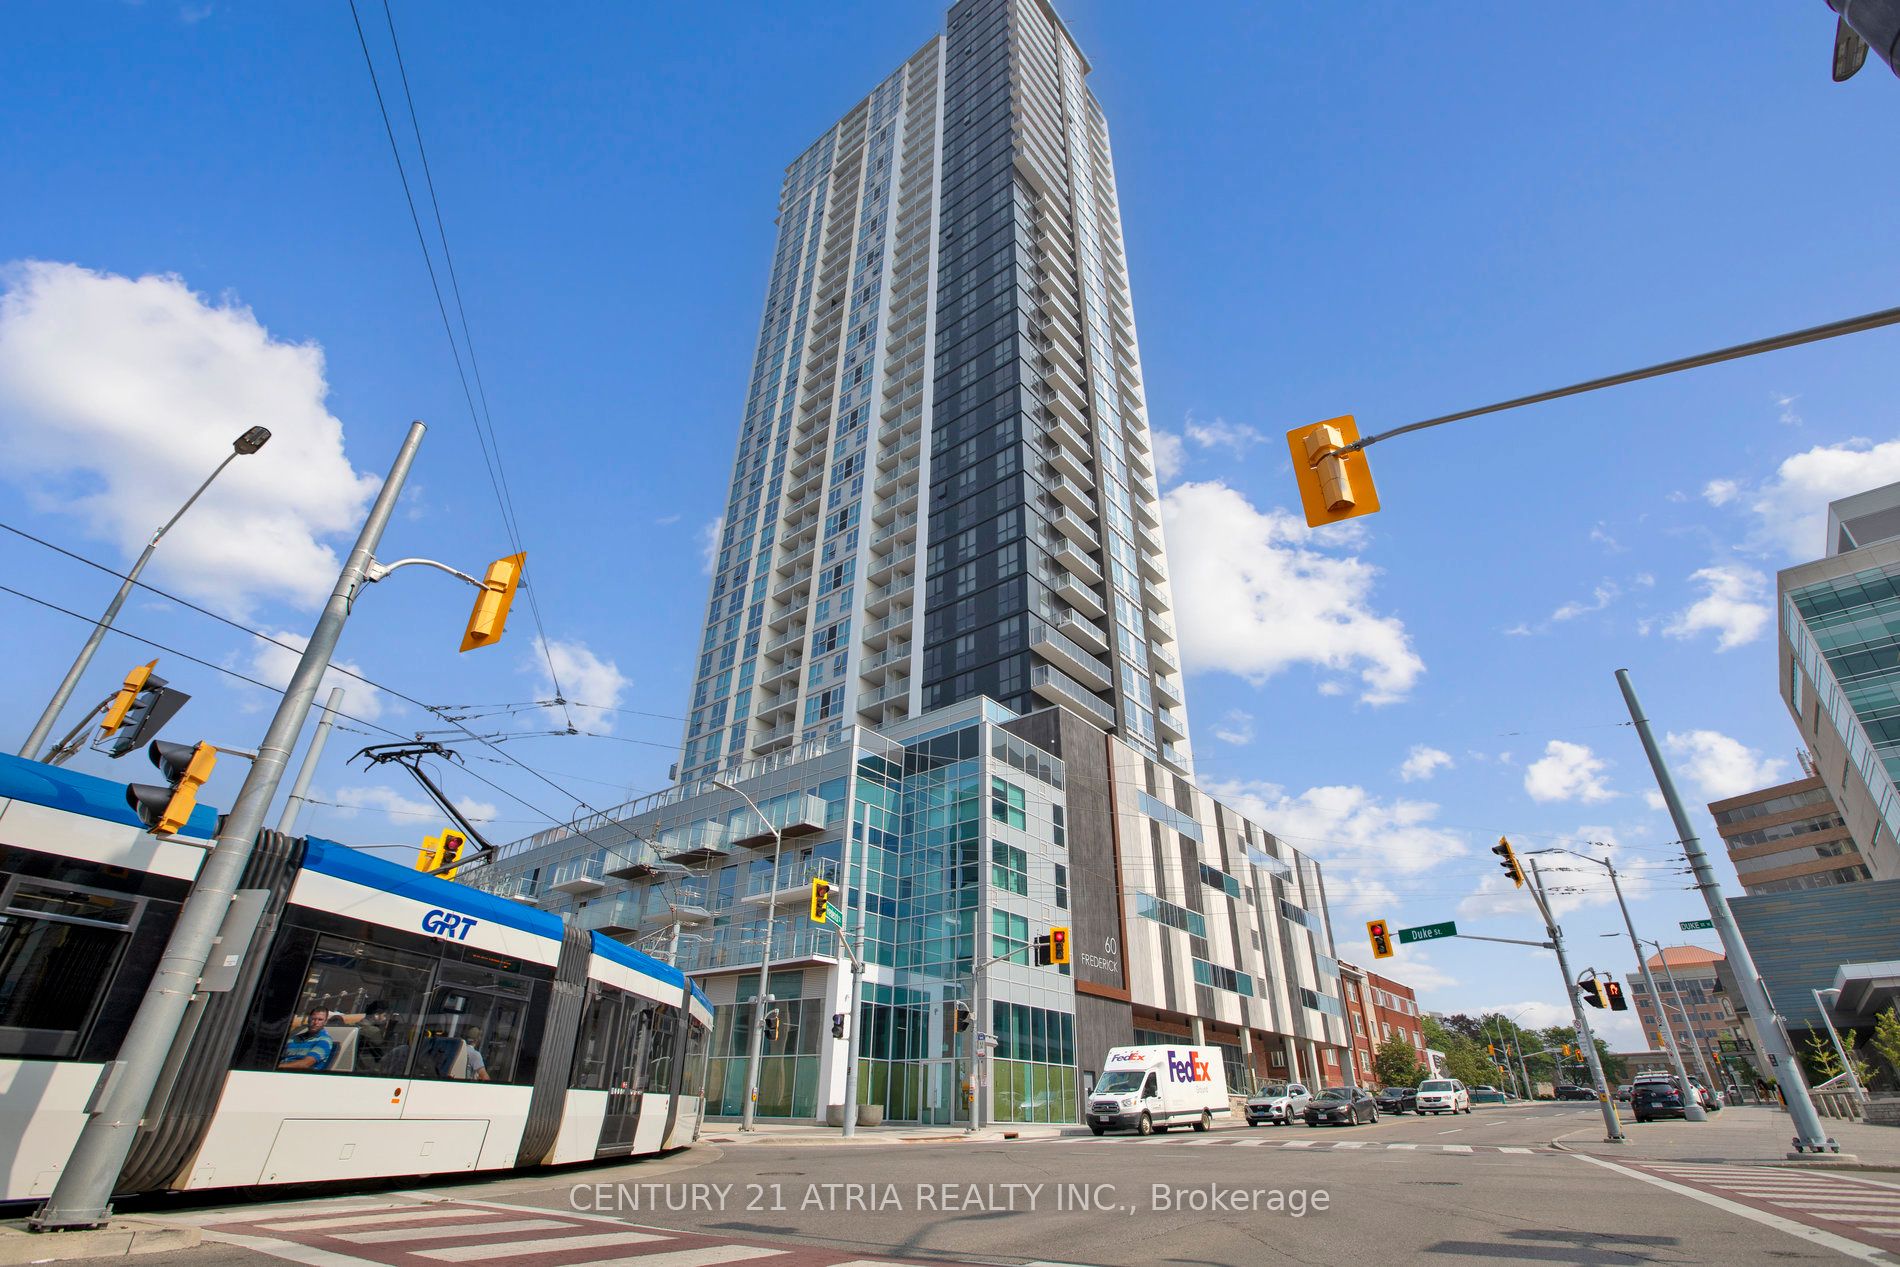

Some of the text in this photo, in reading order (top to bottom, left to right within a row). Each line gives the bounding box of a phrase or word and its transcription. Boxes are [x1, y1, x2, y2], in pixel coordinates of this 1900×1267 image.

[421, 909, 478, 940] GRT
[1411, 928, 1433, 940] Duke
[1680, 922, 1700, 930] DUKE
[1105, 936, 1117, 955] 60
[1081, 953, 1118, 973] FREDERICK
[1111, 1052, 1146, 1063] FedEx
[1167, 1050, 1212, 1083] FedEx
